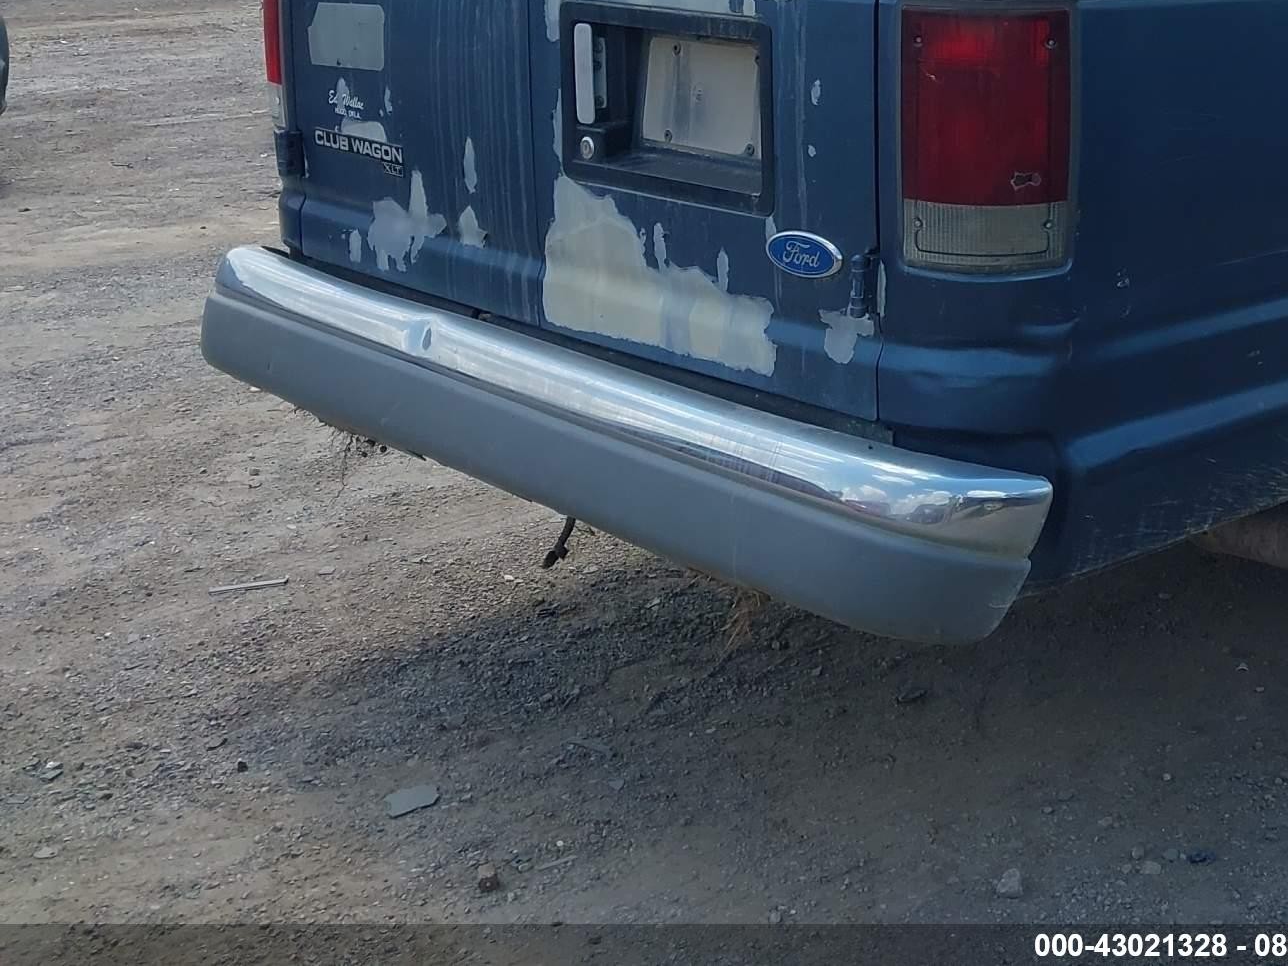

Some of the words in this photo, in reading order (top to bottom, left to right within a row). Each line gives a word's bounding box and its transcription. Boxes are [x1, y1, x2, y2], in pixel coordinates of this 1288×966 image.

[315, 130, 349, 151] CLUB
[352, 137, 403, 164] WAGON
[782, 240, 820, 268] Ford
